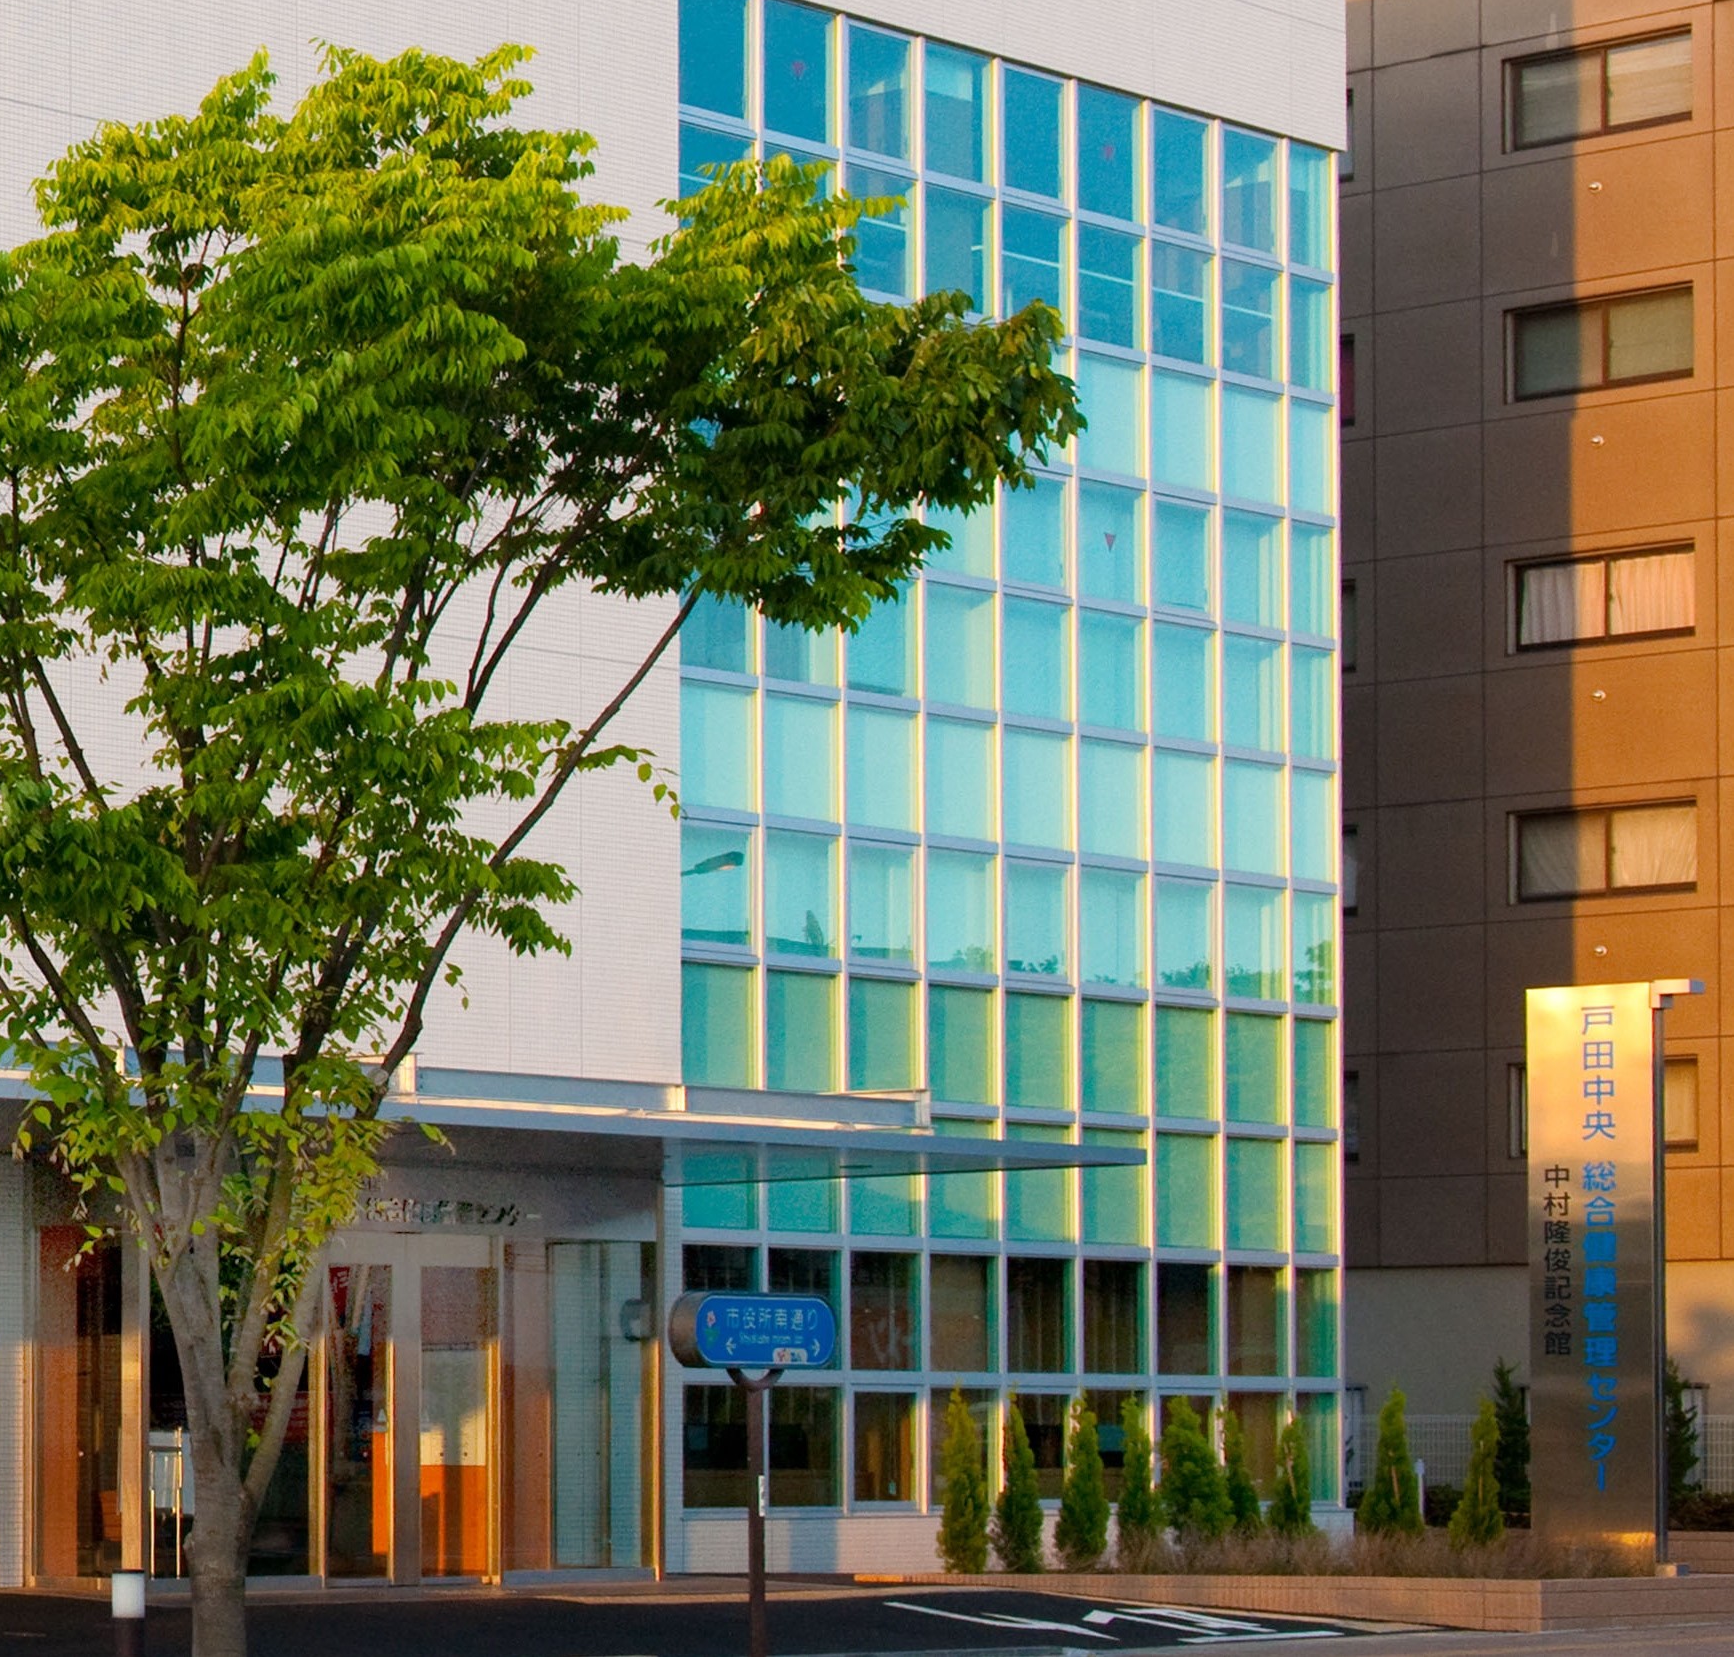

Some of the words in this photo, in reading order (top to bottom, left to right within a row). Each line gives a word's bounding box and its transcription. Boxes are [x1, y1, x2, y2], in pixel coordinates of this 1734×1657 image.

[1581, 1005, 1616, 1141] 戸田中央
[1543, 1164, 1572, 1356] 中村隆俊記念館
[1582, 1160, 1618, 1492] 総合健康管理センター
